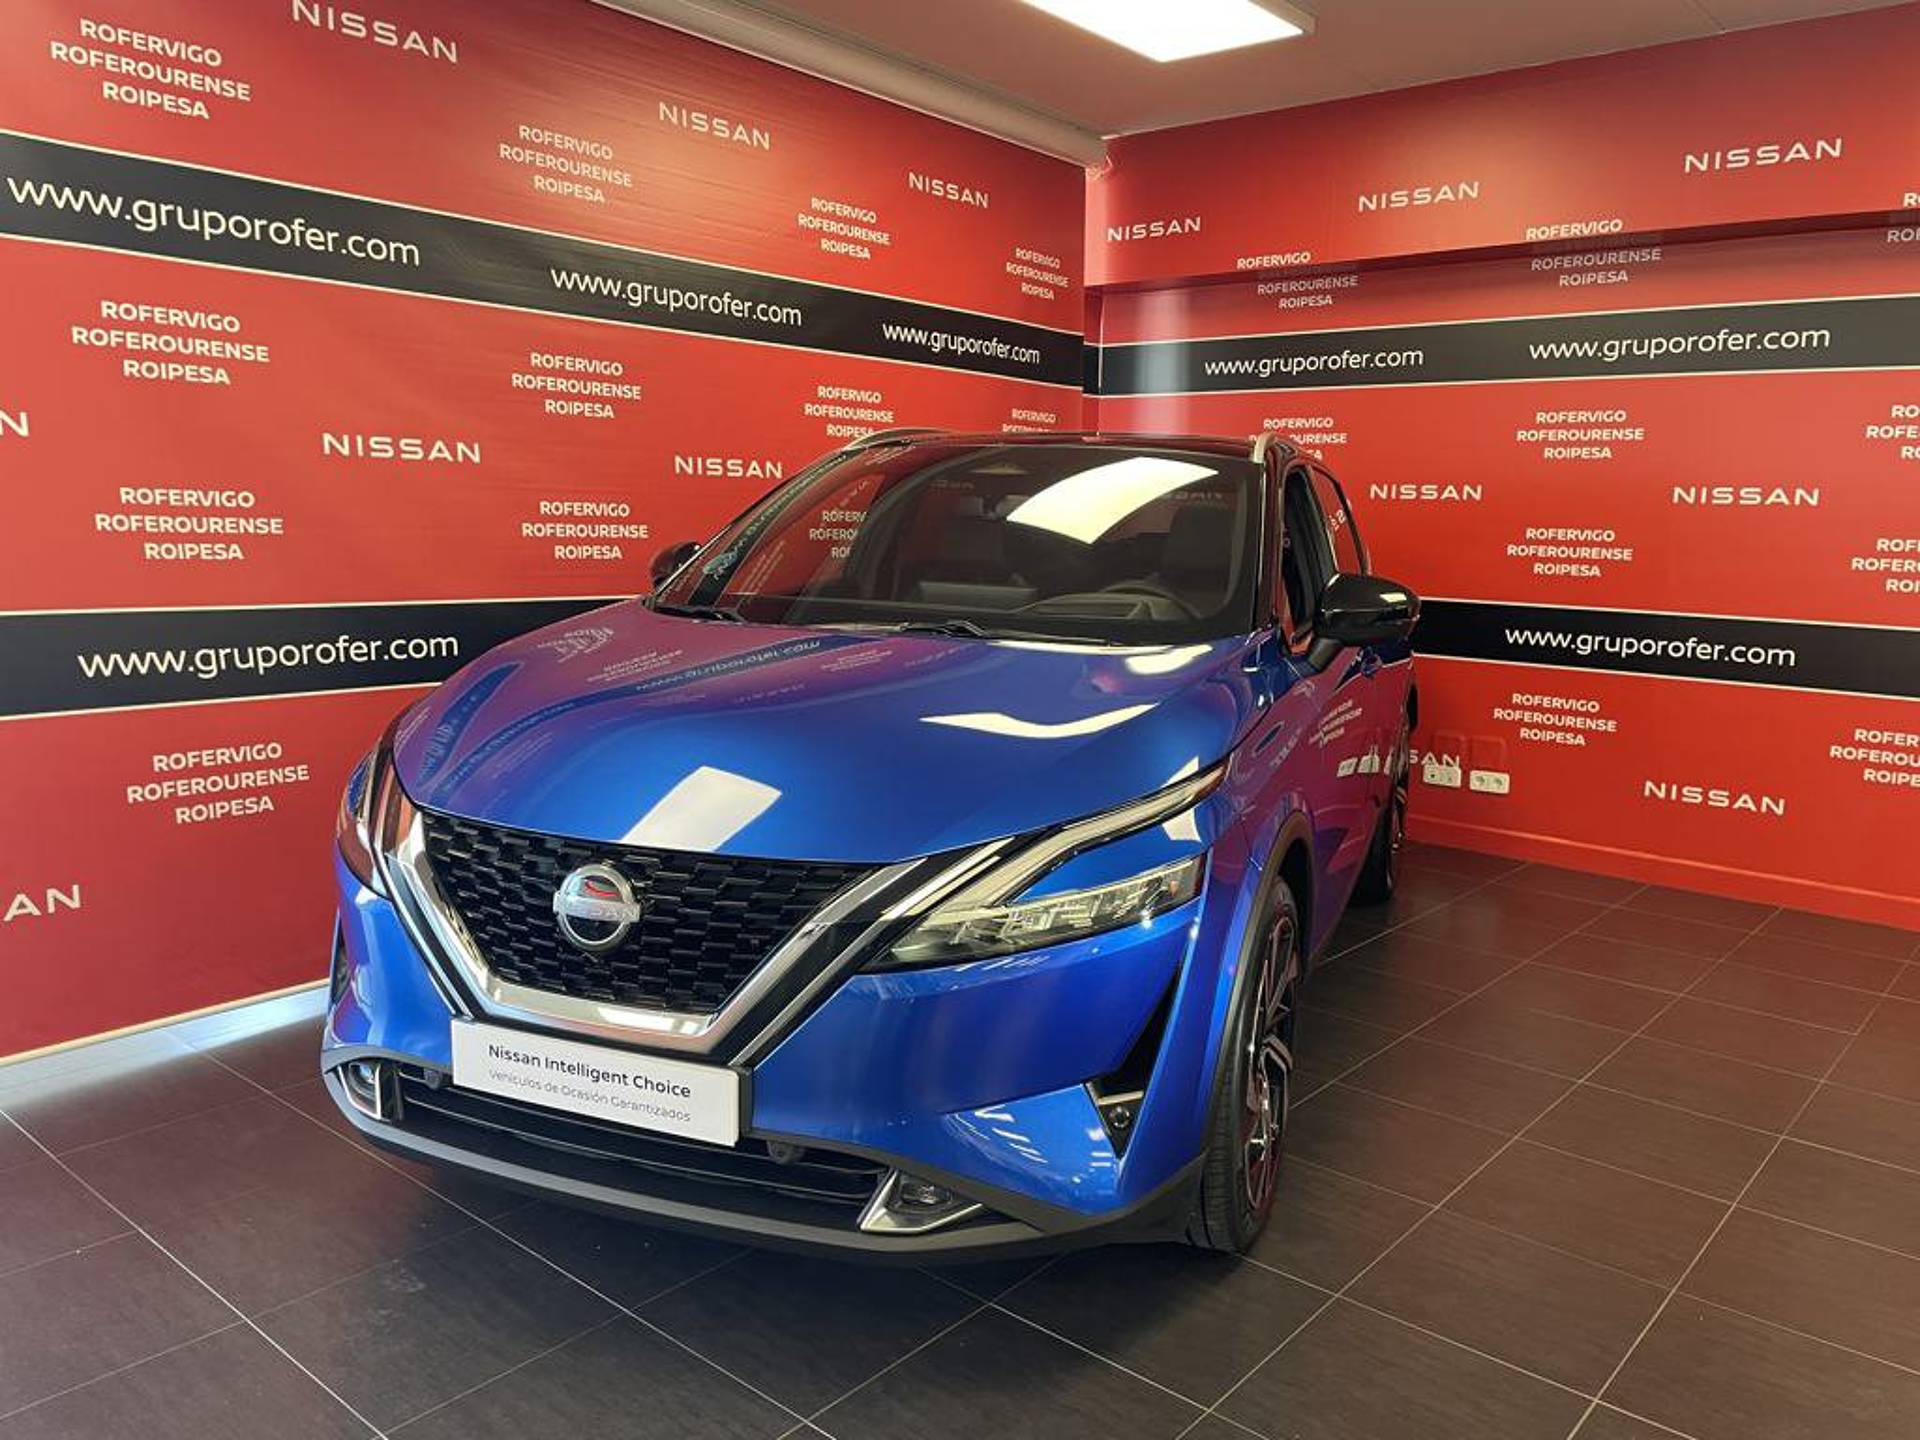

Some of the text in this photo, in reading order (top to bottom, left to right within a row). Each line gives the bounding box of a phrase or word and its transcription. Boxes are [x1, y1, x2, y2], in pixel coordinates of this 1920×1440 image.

[80, 19, 222, 67] ROFERVIGO
[290, 0, 458, 63] NISSAN
[50, 41, 250, 102] ROFEROURENSE
[102, 82, 209, 119] ROIPESA
[659, 102, 771, 150] NISSAN
[519, 124, 613, 161] ROFERVIGO
[1684, 138, 1842, 172] NISSAN
[500, 143, 632, 188] ROFEROURENSE
[533, 174, 605, 203] ROIPESA
[909, 172, 989, 208] NISSAN
[1358, 181, 1480, 212] NISSAN
[7, 176, 420, 266] www.gruporofer.com
[811, 197, 877, 224] ROFERVIGO
[798, 214, 890, 246] ROFEROURENSE
[1108, 216, 1201, 242] NISSAN
[1526, 219, 1623, 241] ROFERVIGO
[821, 238, 870, 260] ROIPESA
[1015, 247, 1060, 269] ROFERVIGO
[1237, 251, 1311, 270] ROFERVIGO
[1531, 249, 1662, 271] ROFEROURENSE
[1006, 262, 1069, 288] ROFEROURENSE
[1257, 274, 1359, 296] ROFEROURENSE
[1559, 271, 1628, 286] ROIPESA
[551, 268, 802, 326] www.gruporofer.com
[1021, 282, 1055, 300] ROIPESA
[1278, 294, 1333, 309] ROIPESA
[101, 300, 240, 333] ROFERVIGO
[71, 326, 270, 363] ROFEROURENSE
[882, 322, 1040, 364] www.gruporofer.com
[1529, 329, 1830, 361] www.gruporofer.com
[122, 358, 230, 385] ROIPESA
[530, 352, 623, 376] ROFERVIGO
[1204, 346, 1425, 379] www.gruporofer.com
[512, 374, 641, 400] ROFEROURENSE
[817, 386, 882, 404] ROFERVIGO
[545, 399, 614, 419] ROIPESA
[804, 403, 894, 423] ROFEROURENSE
[1536, 409, 1626, 425] ROFERVIGO
[1263, 416, 1334, 431] ROFERVIGO
[1516, 427, 1645, 442] ROFEROURENSE
[322, 433, 481, 464] NISSAN
[1544, 446, 1612, 460] ROIPESA
[674, 455, 783, 480] NISSAN
[119, 487, 255, 508] ROFERVIGO
[1370, 484, 1482, 501] NISSAN
[1672, 486, 1820, 507] NISSAN
[540, 501, 630, 518] ROFERVIGO
[94, 513, 283, 535] ROFEROURENSE
[522, 522, 649, 539] ROFEROURENSE
[1526, 527, 1616, 543] ROFERVIGO
[144, 543, 244, 560] ROIPESA
[554, 545, 622, 560] ROIPESA
[1507, 544, 1633, 561] ROFEROURENSE
[1533, 562, 1601, 578] ROIPESA
[77, 635, 459, 679] www.gruporofer.com
[1506, 628, 1796, 667] www.gruporofer.com
[1512, 693, 1600, 713] ROFERVIGO
[1494, 708, 1617, 732] ROFEROURENSE
[1520, 727, 1586, 746] ROIPESA
[153, 742, 282, 773] ROFERVIGO
[127, 765, 310, 803] ROFEROURENSE
[175, 796, 274, 824] ROIPESA
[1643, 780, 1785, 816] NISSAN
[488, 1044, 691, 1097] Nissan Intelligent Choice
